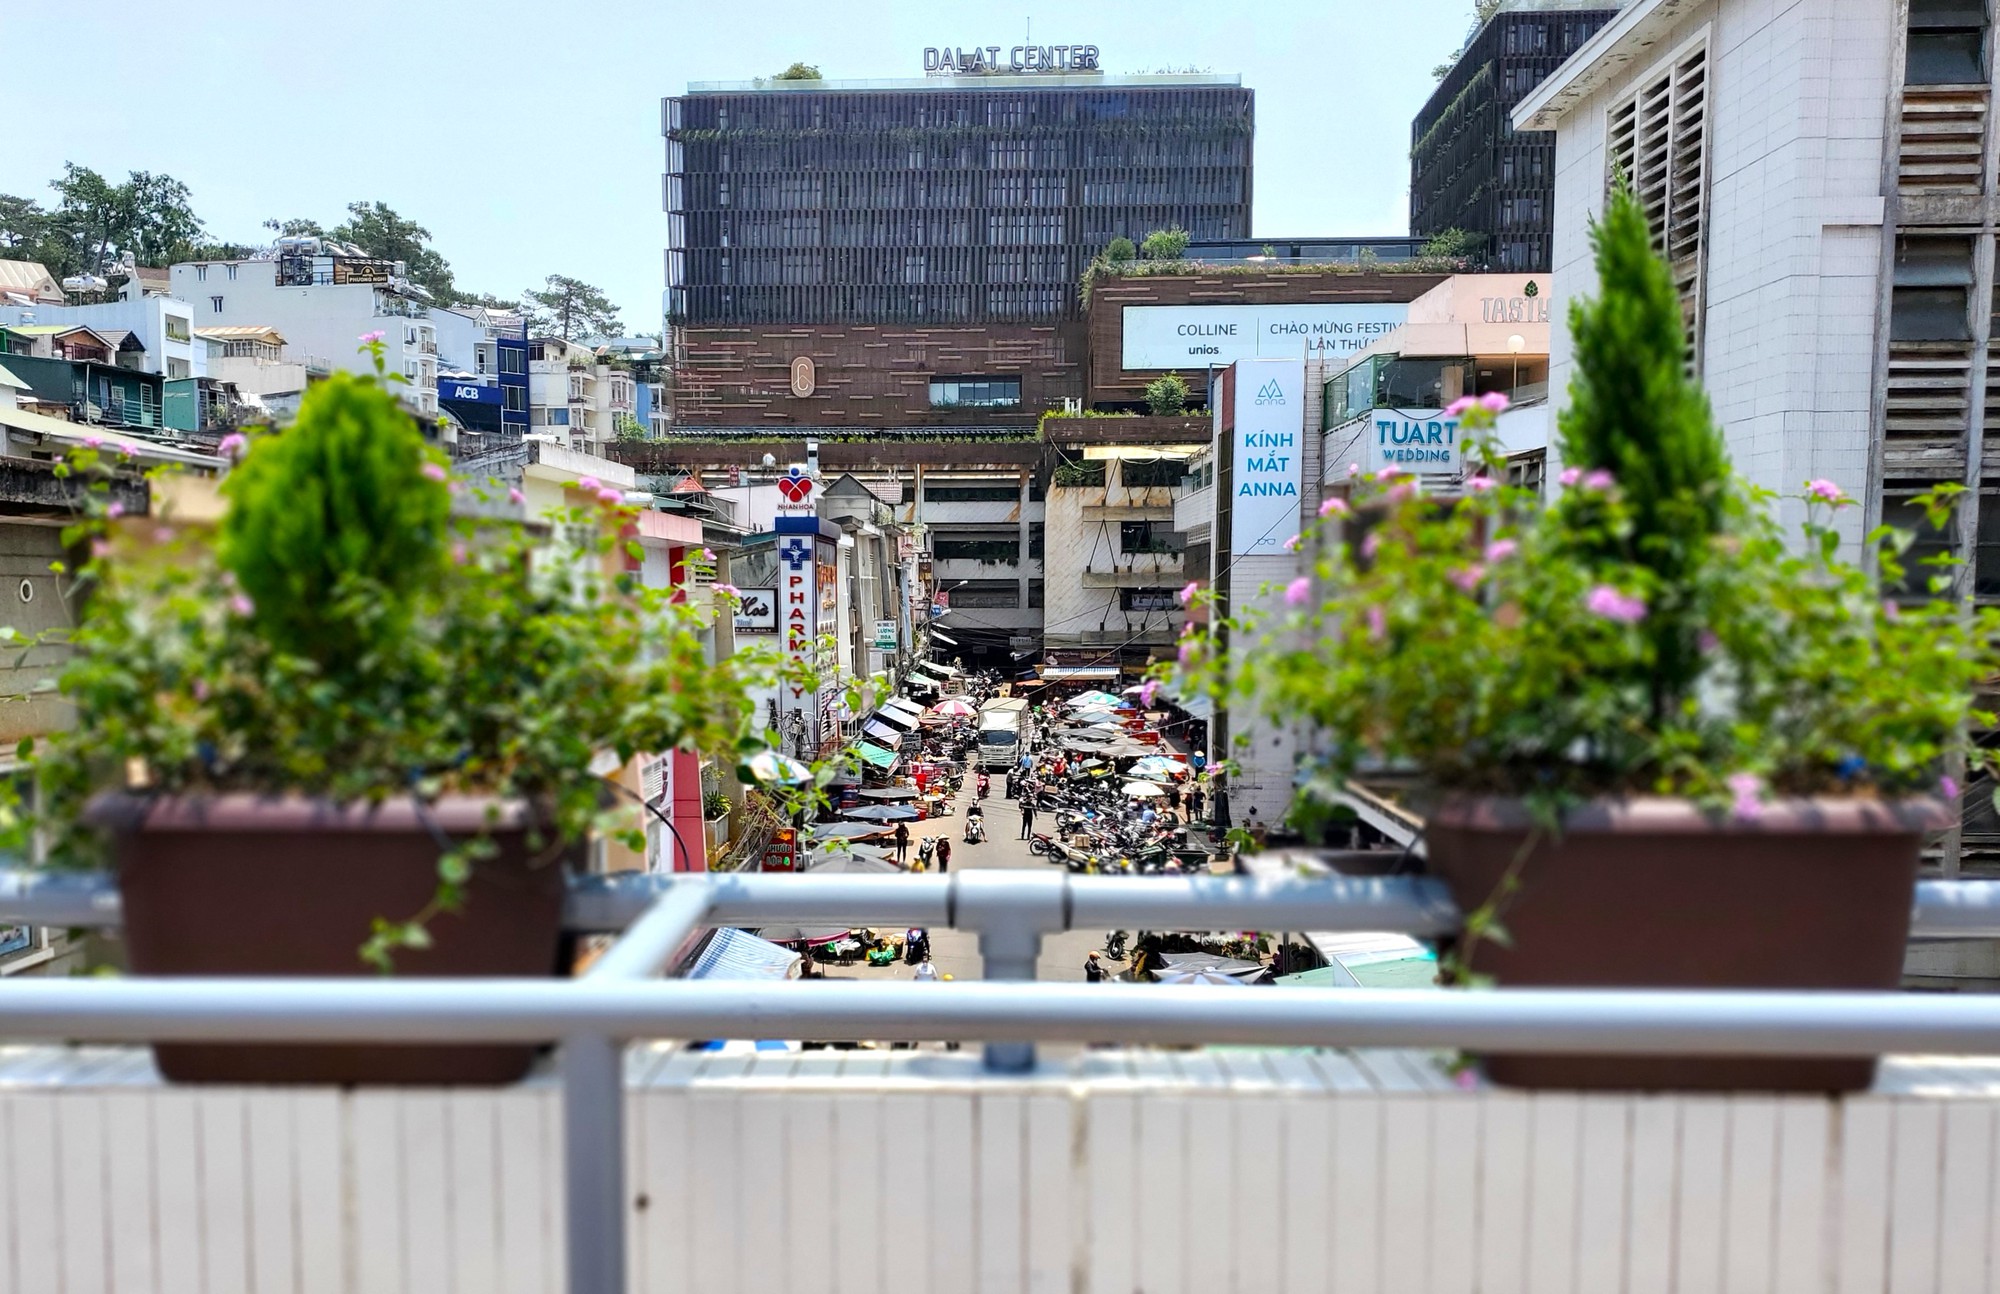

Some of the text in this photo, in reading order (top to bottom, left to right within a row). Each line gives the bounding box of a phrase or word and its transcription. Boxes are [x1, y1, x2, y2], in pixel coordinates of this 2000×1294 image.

[924, 45, 1100, 71] DALAT CENTER
[1480, 297, 1551, 321] TASTY
[1177, 324, 1238, 336] COLLINE
[1269, 320, 1309, 335] CHÀO
[1313, 320, 1353, 334] MỪNG
[455, 386, 479, 399] ACB
[1255, 398, 1286, 406] anna
[1245, 429, 1293, 447] KÍNH
[1376, 421, 1459, 445] TUART
[1247, 450, 1290, 472] MẮT
[1383, 447, 1450, 462] WEDDING
[1239, 482, 1297, 496] ANNA
